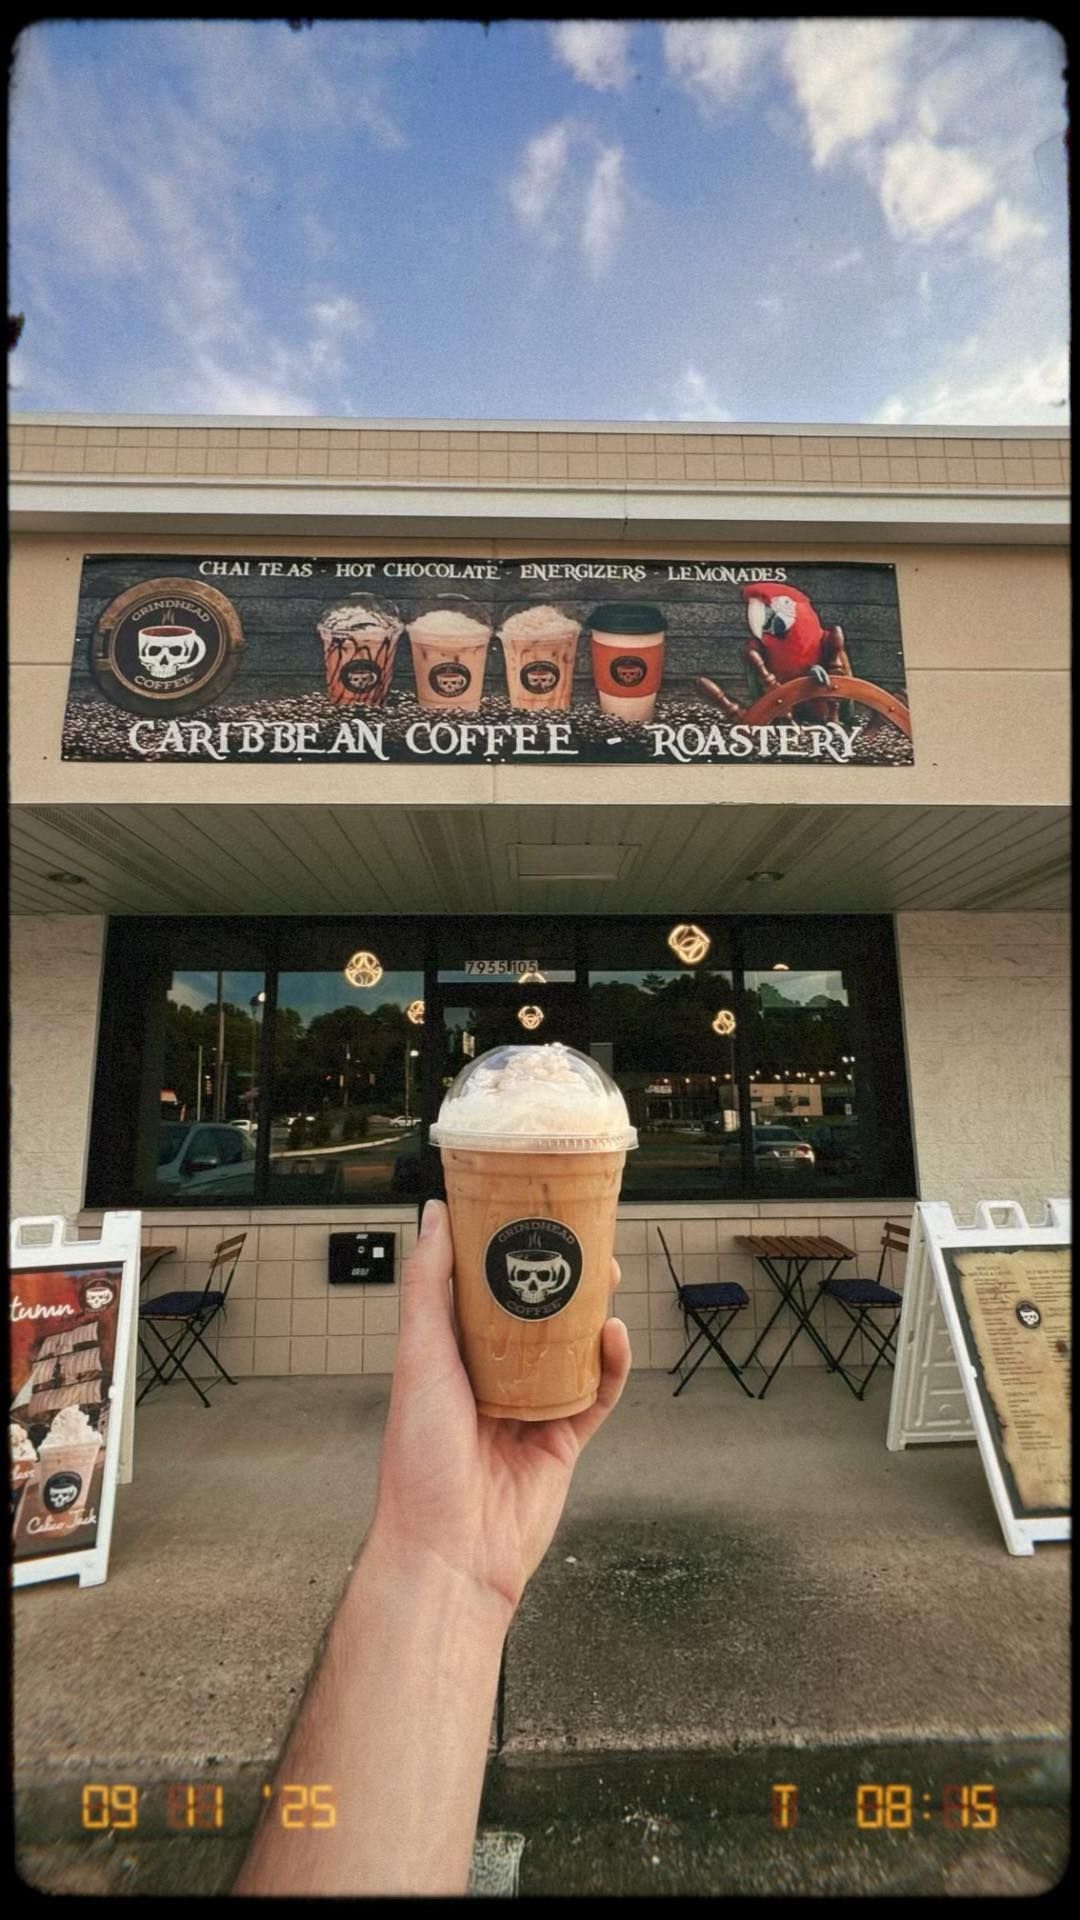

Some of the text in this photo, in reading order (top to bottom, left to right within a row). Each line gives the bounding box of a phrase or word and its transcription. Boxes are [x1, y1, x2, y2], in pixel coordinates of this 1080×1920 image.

[199, 561, 250, 576] CHAI
[258, 562, 313, 577] TEAS
[335, 563, 376, 578] HOT
[382, 563, 501, 580] CHOCOLATE
[519, 563, 647, 582] ENERGIZERS
[667, 565, 788, 585] LEMONADES
[131, 600, 211, 622] GRINDHEAD
[134, 674, 194, 690] COFFEE
[128, 719, 390, 761] CARIBBEAN
[405, 722, 578, 756] COFFEE
[645, 723, 862, 763] ROASTERY
[467, 961, 537, 974] 7955 105
[497, 1221, 575, 1245] GRINDHEAD
